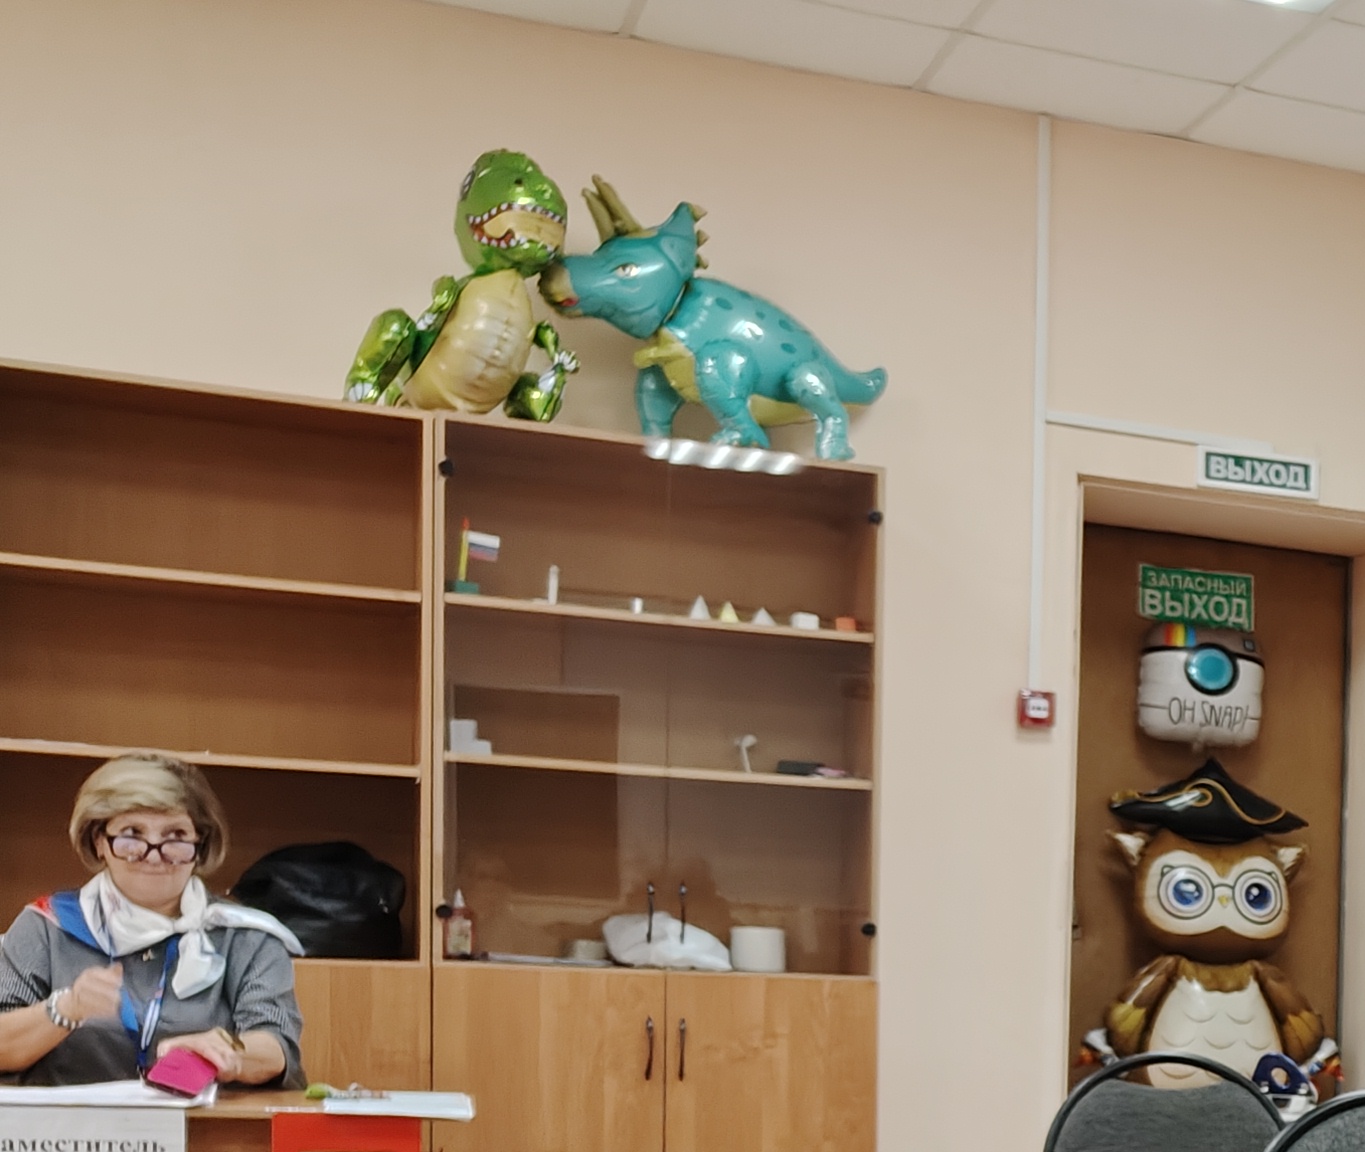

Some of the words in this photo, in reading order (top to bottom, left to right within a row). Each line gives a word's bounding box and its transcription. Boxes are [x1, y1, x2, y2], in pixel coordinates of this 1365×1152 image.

[1208, 455, 1307, 490] ВЫХОД
[1147, 571, 1247, 597] ЗАПАСНЫЙ
[1144, 588, 1249, 629] ВЫХОД
[1168, 696, 1196, 726] OH
